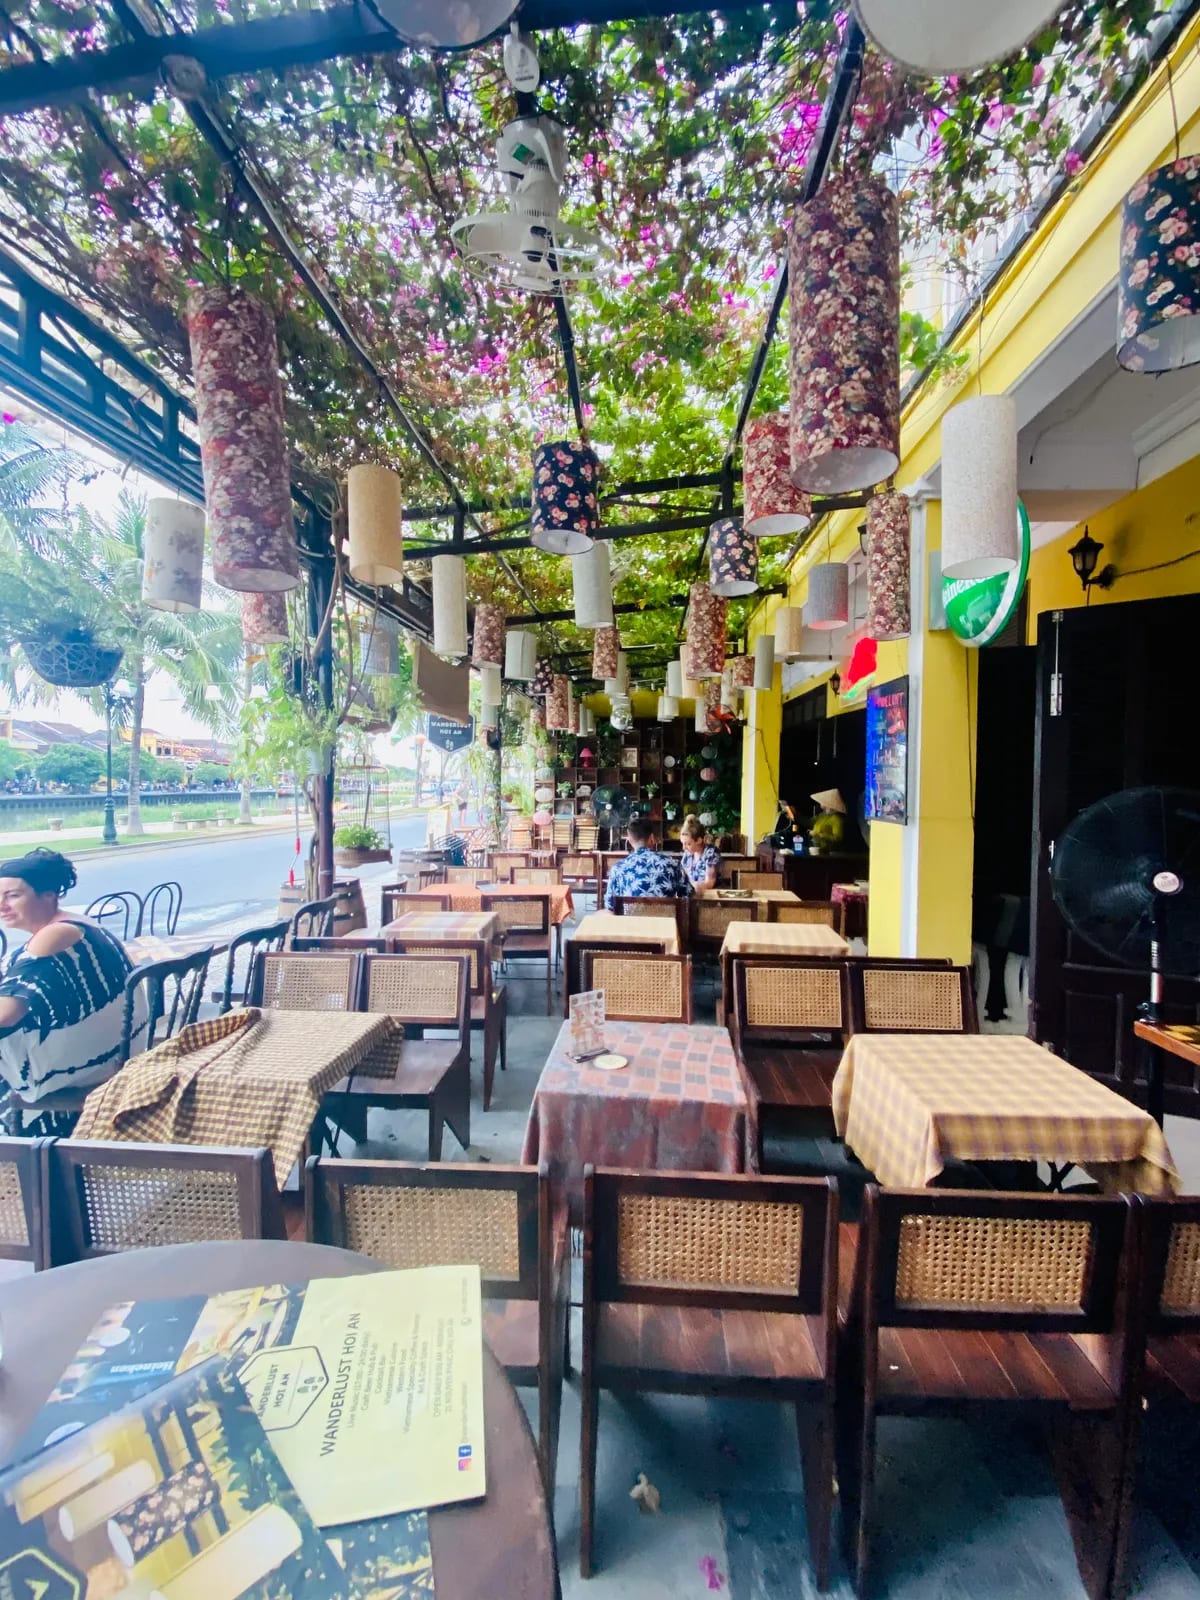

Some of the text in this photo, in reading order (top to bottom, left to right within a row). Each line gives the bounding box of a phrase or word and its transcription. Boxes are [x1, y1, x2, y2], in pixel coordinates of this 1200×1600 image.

[256, 1362, 278, 1417] ANDERLUST
[273, 1371, 290, 1408] HOI AN
[320, 1312, 361, 1457] WANDERLUST HOI AN
